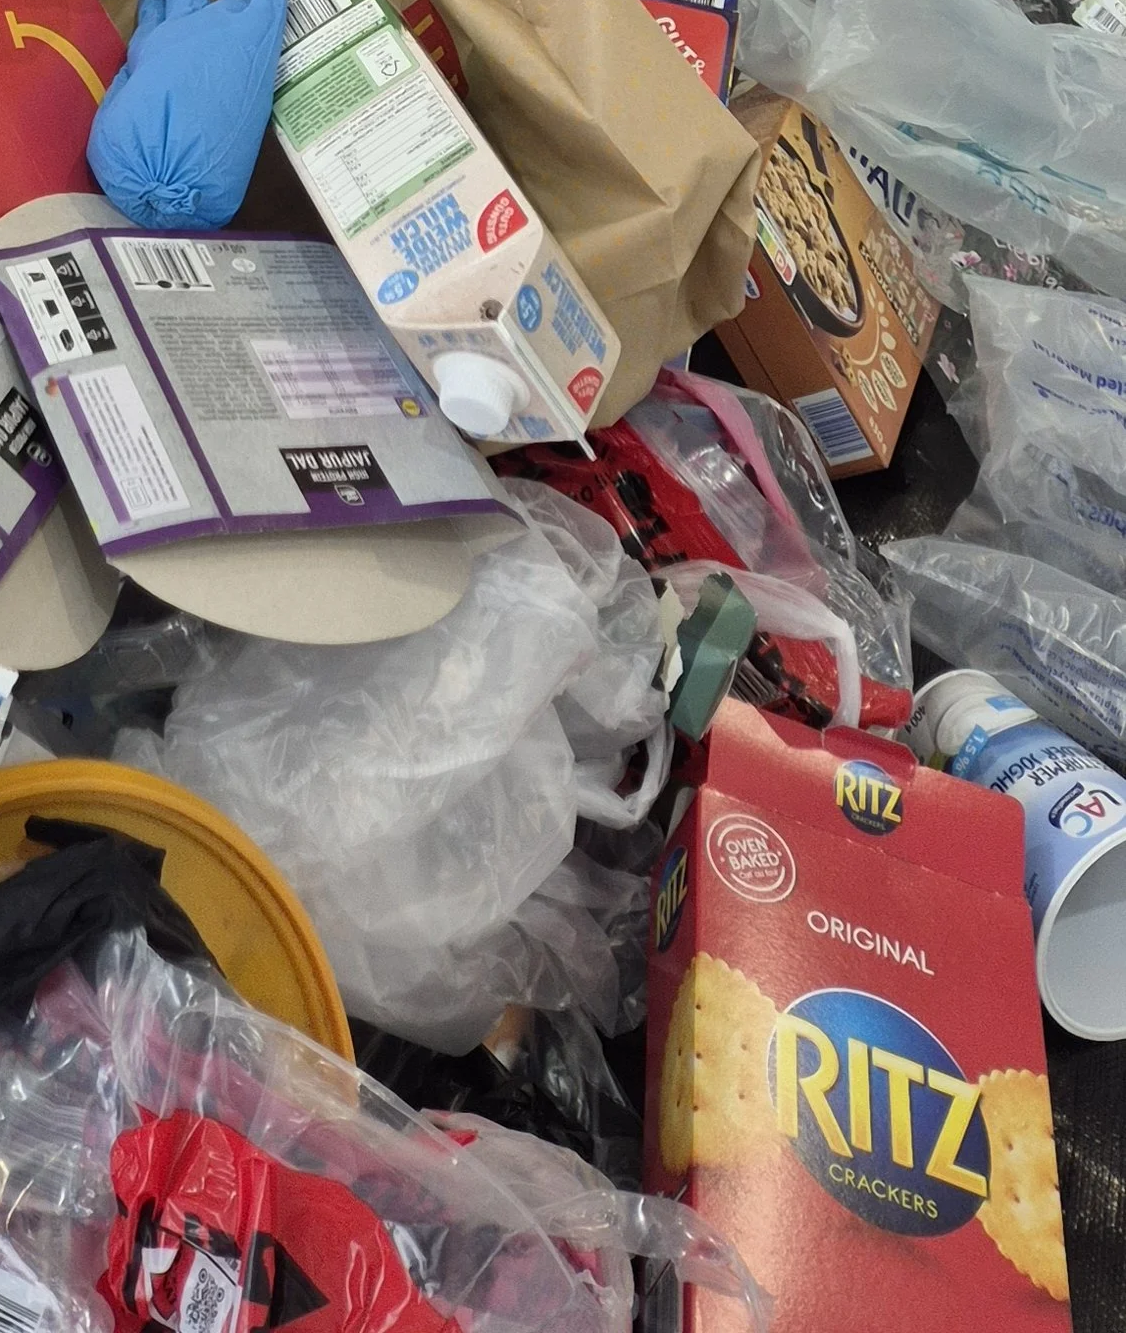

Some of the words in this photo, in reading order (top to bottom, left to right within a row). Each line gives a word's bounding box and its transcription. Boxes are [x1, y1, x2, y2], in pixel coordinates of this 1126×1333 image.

[285, 451, 320, 471] DAL
[318, 450, 372, 469] JAIPUR
[835, 766, 902, 824] RITZ
[1064, 786, 1122, 838] LAC
[725, 836, 768, 855] OVEN
[728, 850, 780, 872] BAKED
[655, 854, 689, 947] RITZ
[806, 909, 935, 976] ORIGINAL
[775, 1011, 989, 1199] RITZ
[827, 1162, 939, 1221] CRACKERS
